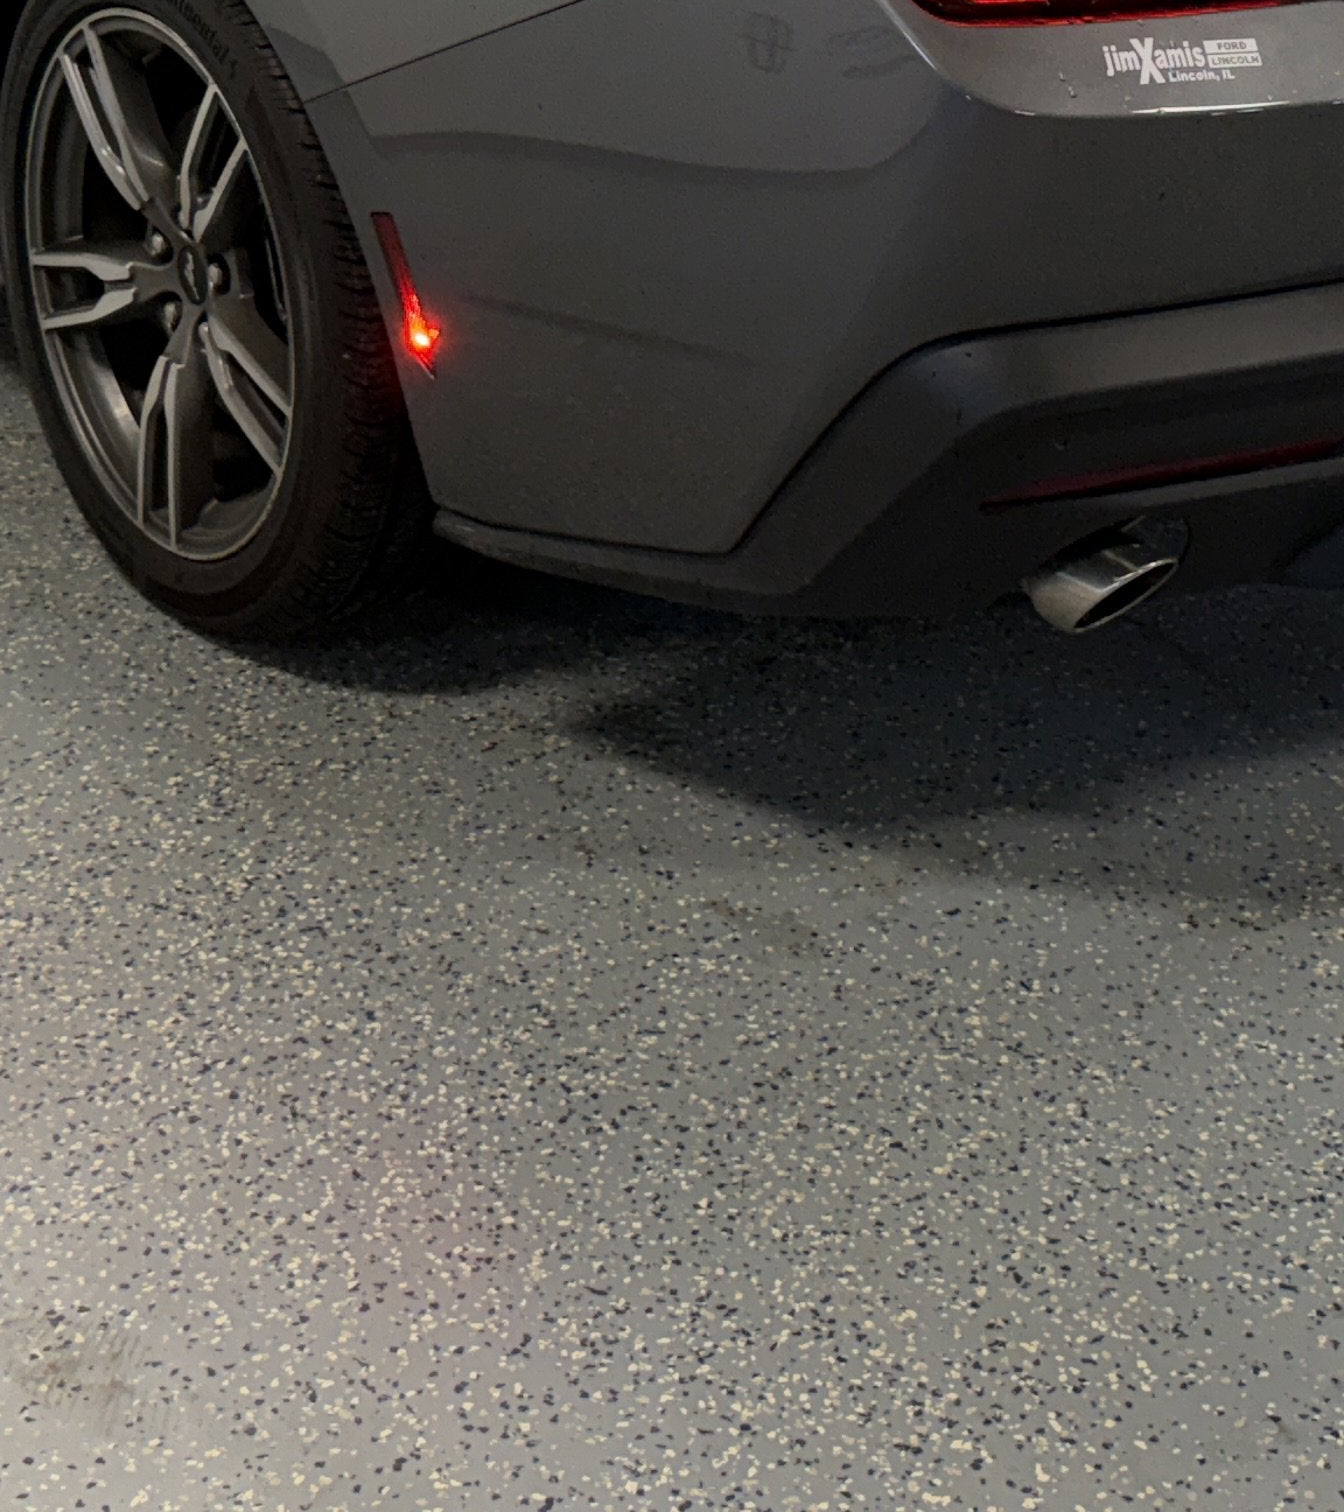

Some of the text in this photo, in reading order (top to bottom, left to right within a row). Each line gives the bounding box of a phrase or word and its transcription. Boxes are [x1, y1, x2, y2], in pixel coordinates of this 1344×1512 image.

[1216, 41, 1247, 51] FORD
[1211, 54, 1261, 66] LINCOLN
[1222, 69, 1235, 80] IL
